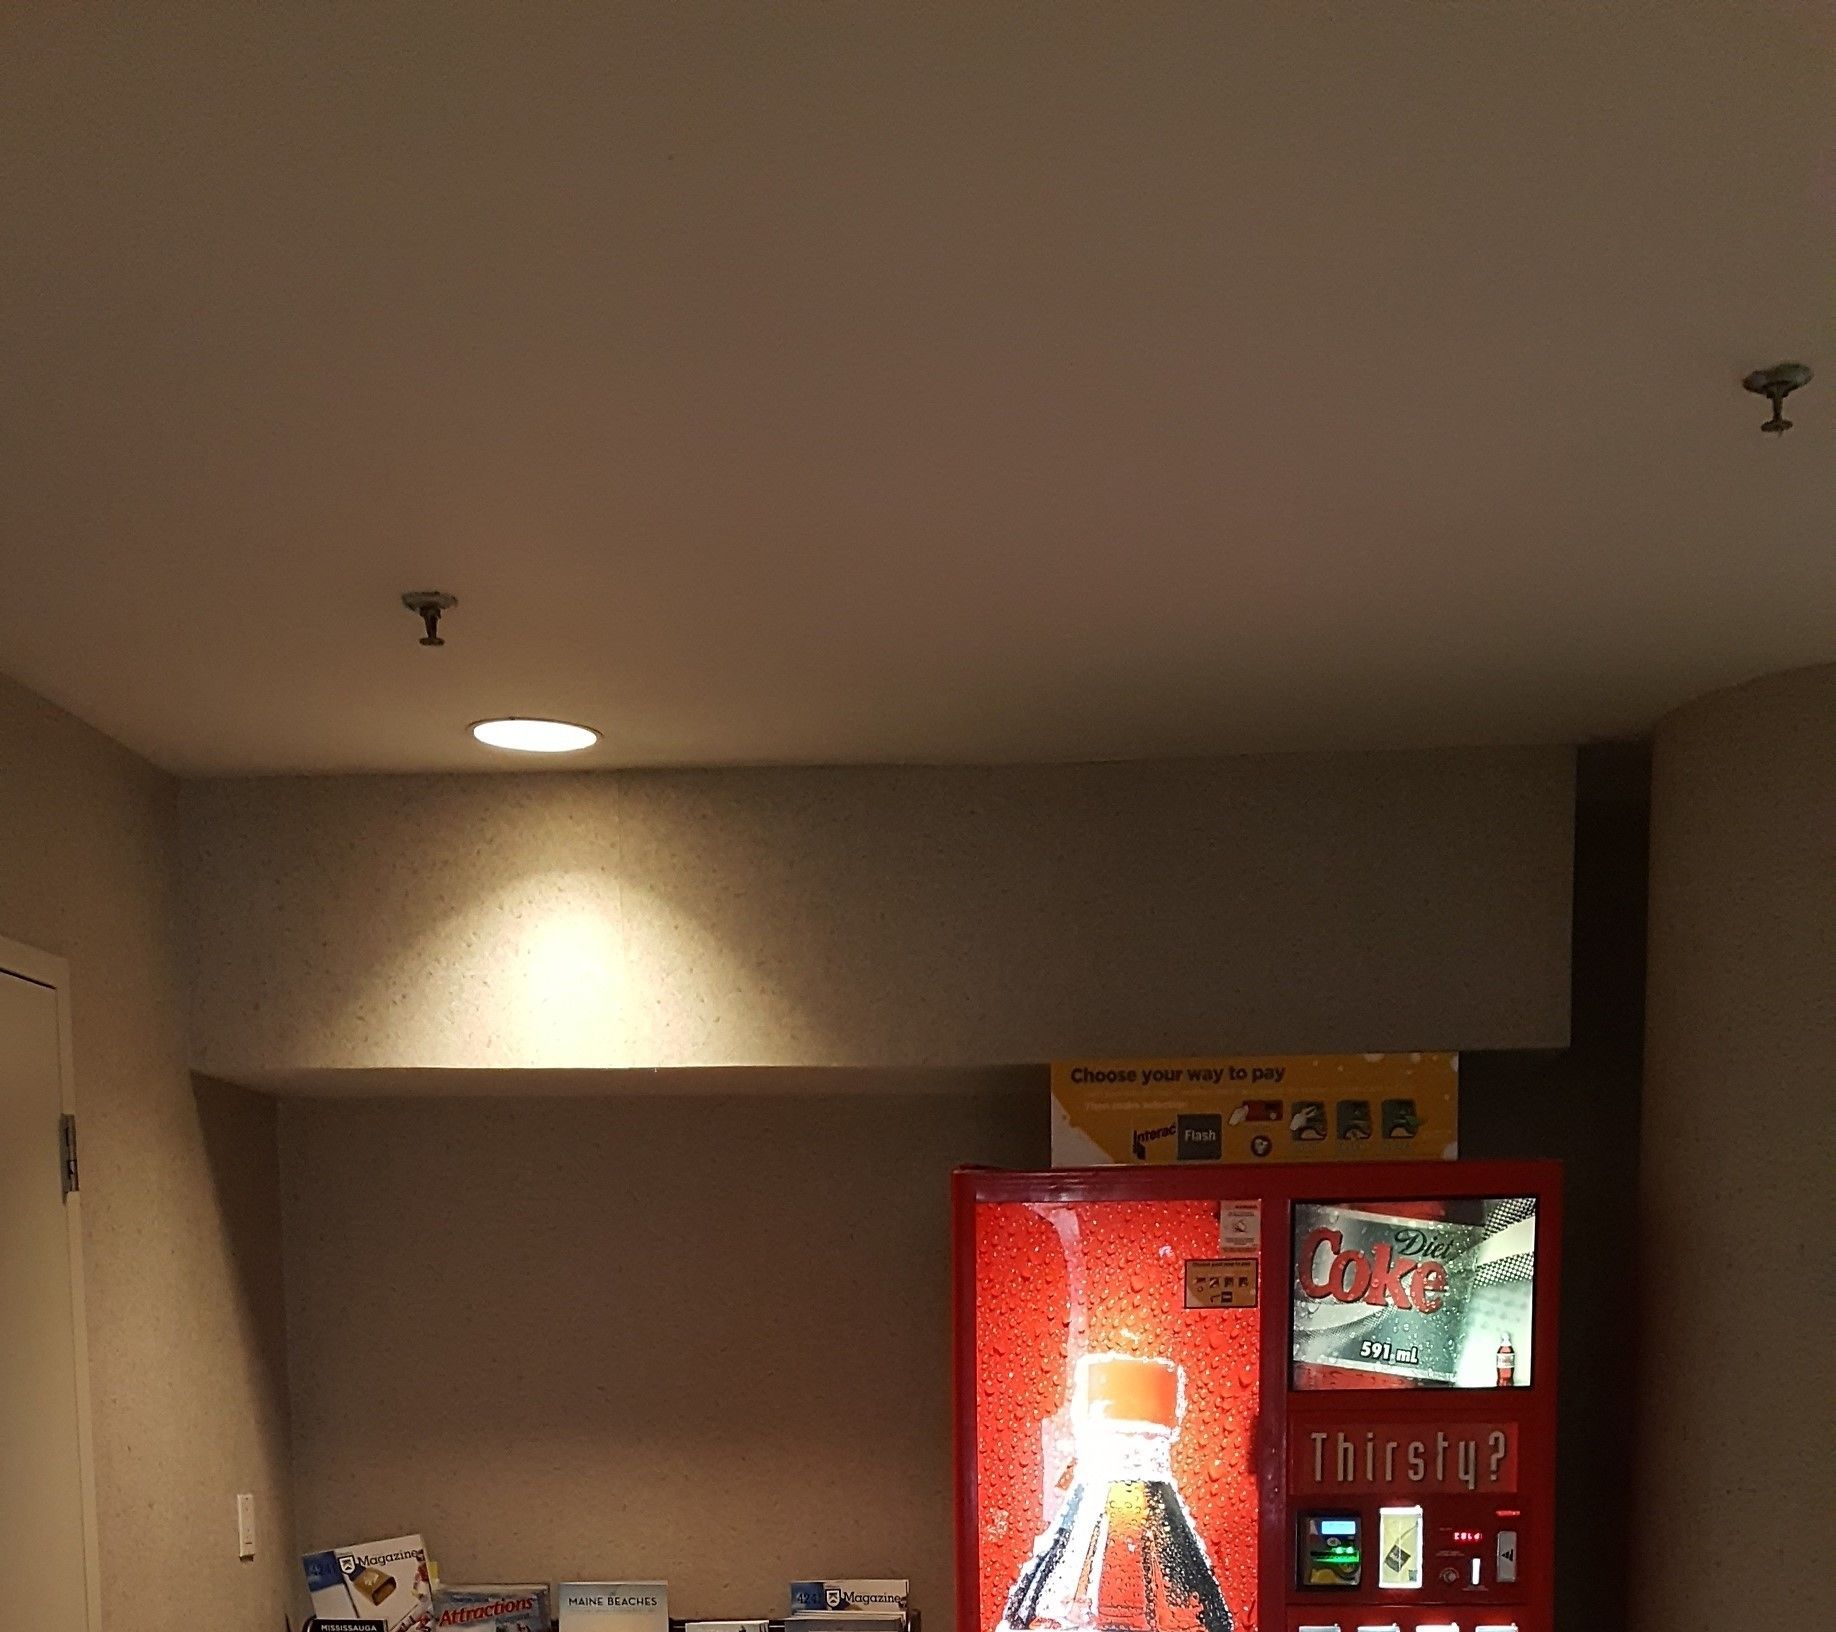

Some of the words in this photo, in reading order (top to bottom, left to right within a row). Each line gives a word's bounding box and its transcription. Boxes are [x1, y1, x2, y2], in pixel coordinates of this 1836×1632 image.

[1070, 1067, 1138, 1084] Choose
[1142, 1069, 1182, 1085] your
[1187, 1069, 1225, 1084] way
[1229, 1067, 1248, 1082] to
[1252, 1067, 1286, 1083] pay
[1132, 1124, 1177, 1146] Interac
[1185, 1128, 1217, 1143] Flash
[1394, 1229, 1453, 1258] Diet
[1300, 1226, 1450, 1315] Coke
[1360, 1340, 1394, 1362] 591
[1310, 1429, 1506, 1490] Thirsty?
[357, 1550, 417, 1567] Magazine
[568, 1597, 603, 1606] MAINE
[607, 1597, 658, 1606] BEACHES
[843, 1591, 901, 1605] Magazine
[439, 1597, 534, 1627] Attractions
[321, 1624, 378, 1632] MISSISSAUGA
